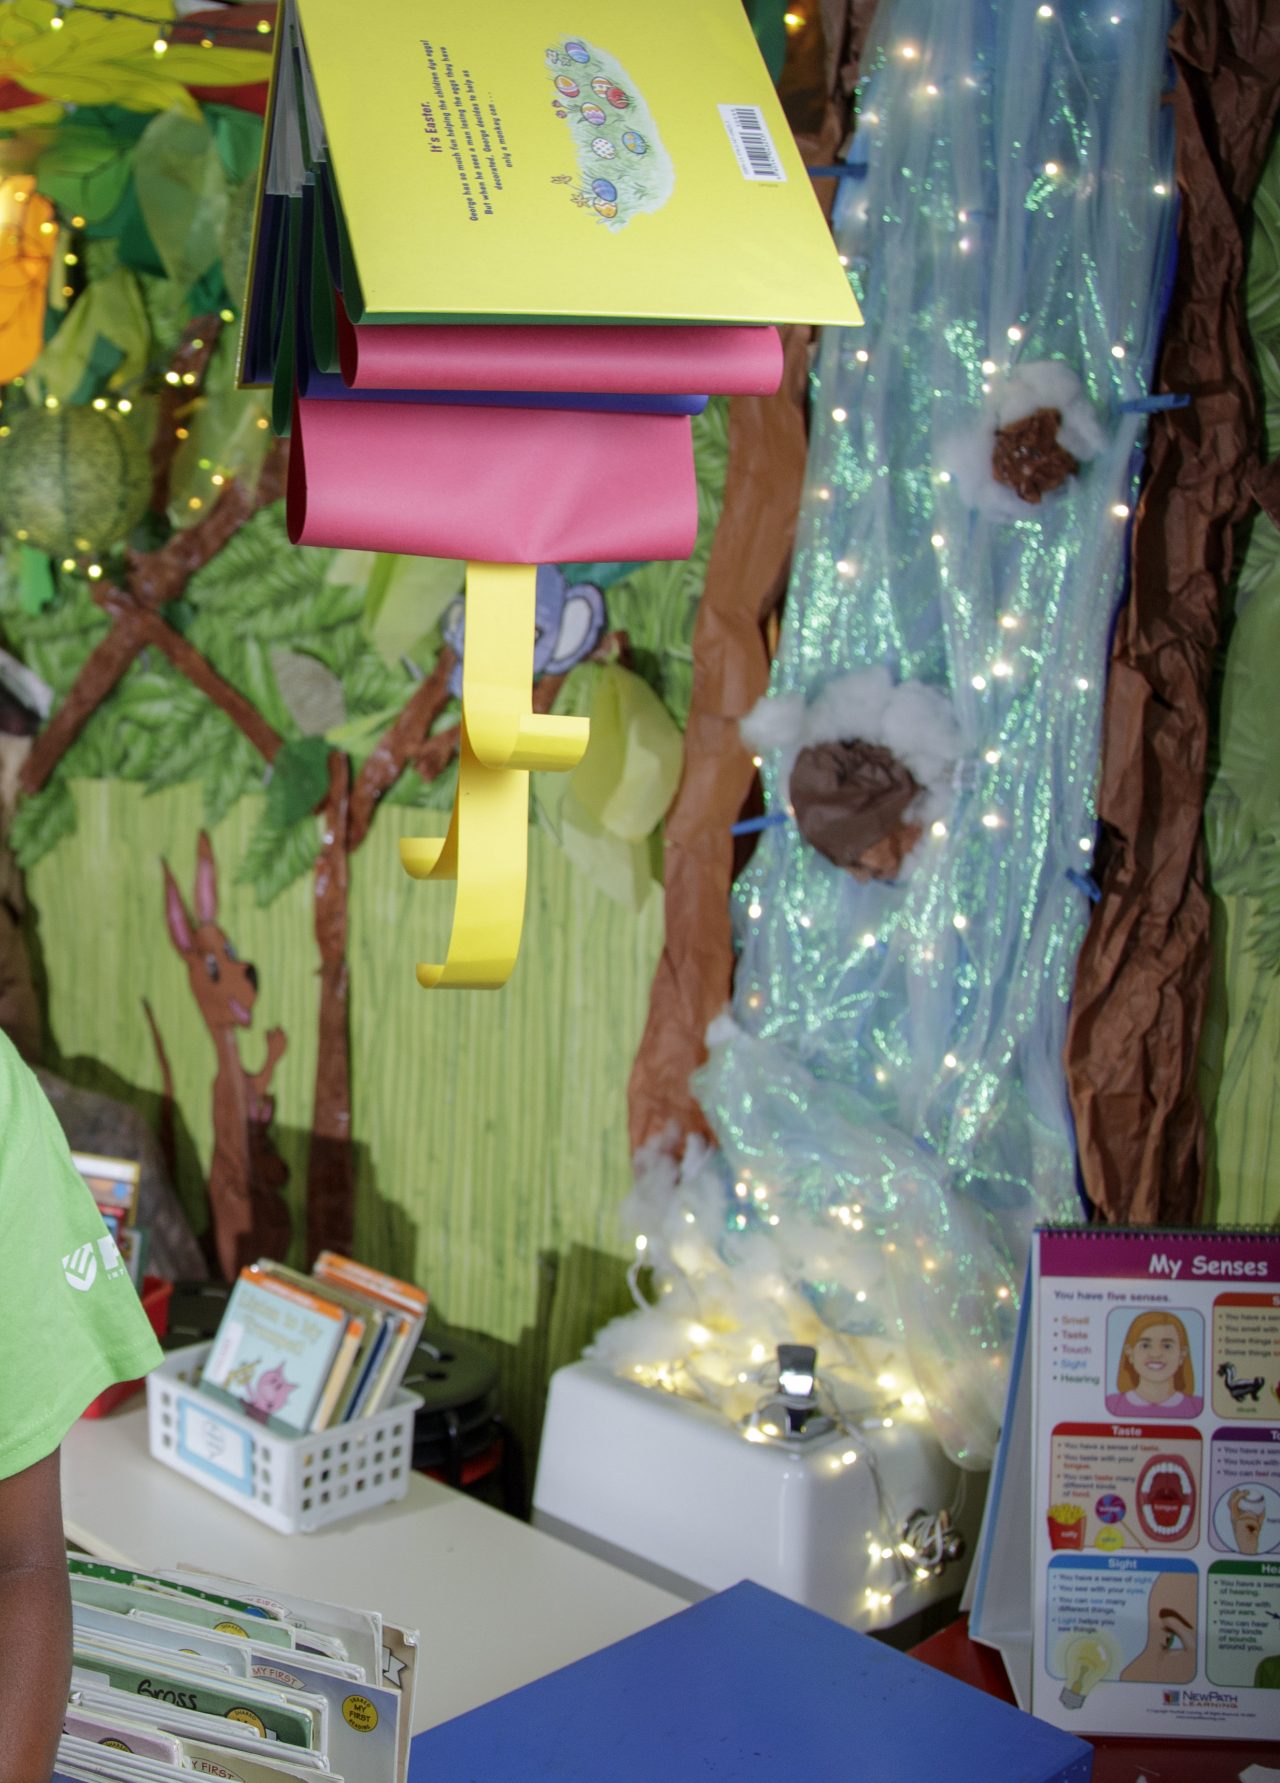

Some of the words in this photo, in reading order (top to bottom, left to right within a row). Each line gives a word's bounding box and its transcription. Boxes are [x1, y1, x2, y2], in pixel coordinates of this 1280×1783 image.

[440, 46, 450, 62] have
[428, 59, 437, 70] dye
[445, 63, 454, 78] they
[431, 72, 444, 98] children
[449, 80, 460, 95] eggs
[465, 79, 475, 93] help
[439, 100, 447, 110] the
[454, 96, 462, 107] the
[472, 103, 485, 128] decides
[443, 112, 455, 137] helping
[493, 117, 505, 144] monkey
[428, 137, 443, 152] It's
[449, 139, 459, 150] fun
[465, 131, 474, 145] man
[480, 129, 492, 152] George
[452, 152, 464, 171] much
[470, 154, 480, 169] sees
[502, 153, 513, 168] only
[460, 172, 467, 180] so
[475, 171, 484, 180] he
[462, 183, 471, 195] has
[479, 182, 489, 200] when
[466, 197, 479, 221] George
[483, 202, 493, 215] But
[1149, 1253, 1182, 1279] My
[1191, 1255, 1268, 1276] Senses
[1054, 1291, 1074, 1301] You
[1077, 1291, 1103, 1301] have
[1107, 1292, 1126, 1301] five
[1061, 1359, 1087, 1369] Sight
[1060, 1375, 1100, 1385] Hearing
[1111, 1425, 1142, 1437] Taste
[1108, 1558, 1137, 1569] Sight
[252, 1667, 266, 1676] MY
[270, 1670, 297, 1685] FIRST
[137, 1679, 197, 1710] Gross
[354, 1704, 367, 1712] MY
[1183, 1702, 1238, 1710] LEARNING
[349, 1710, 371, 1723] FIRST
[201, 1763, 235, 1780] FIRST
